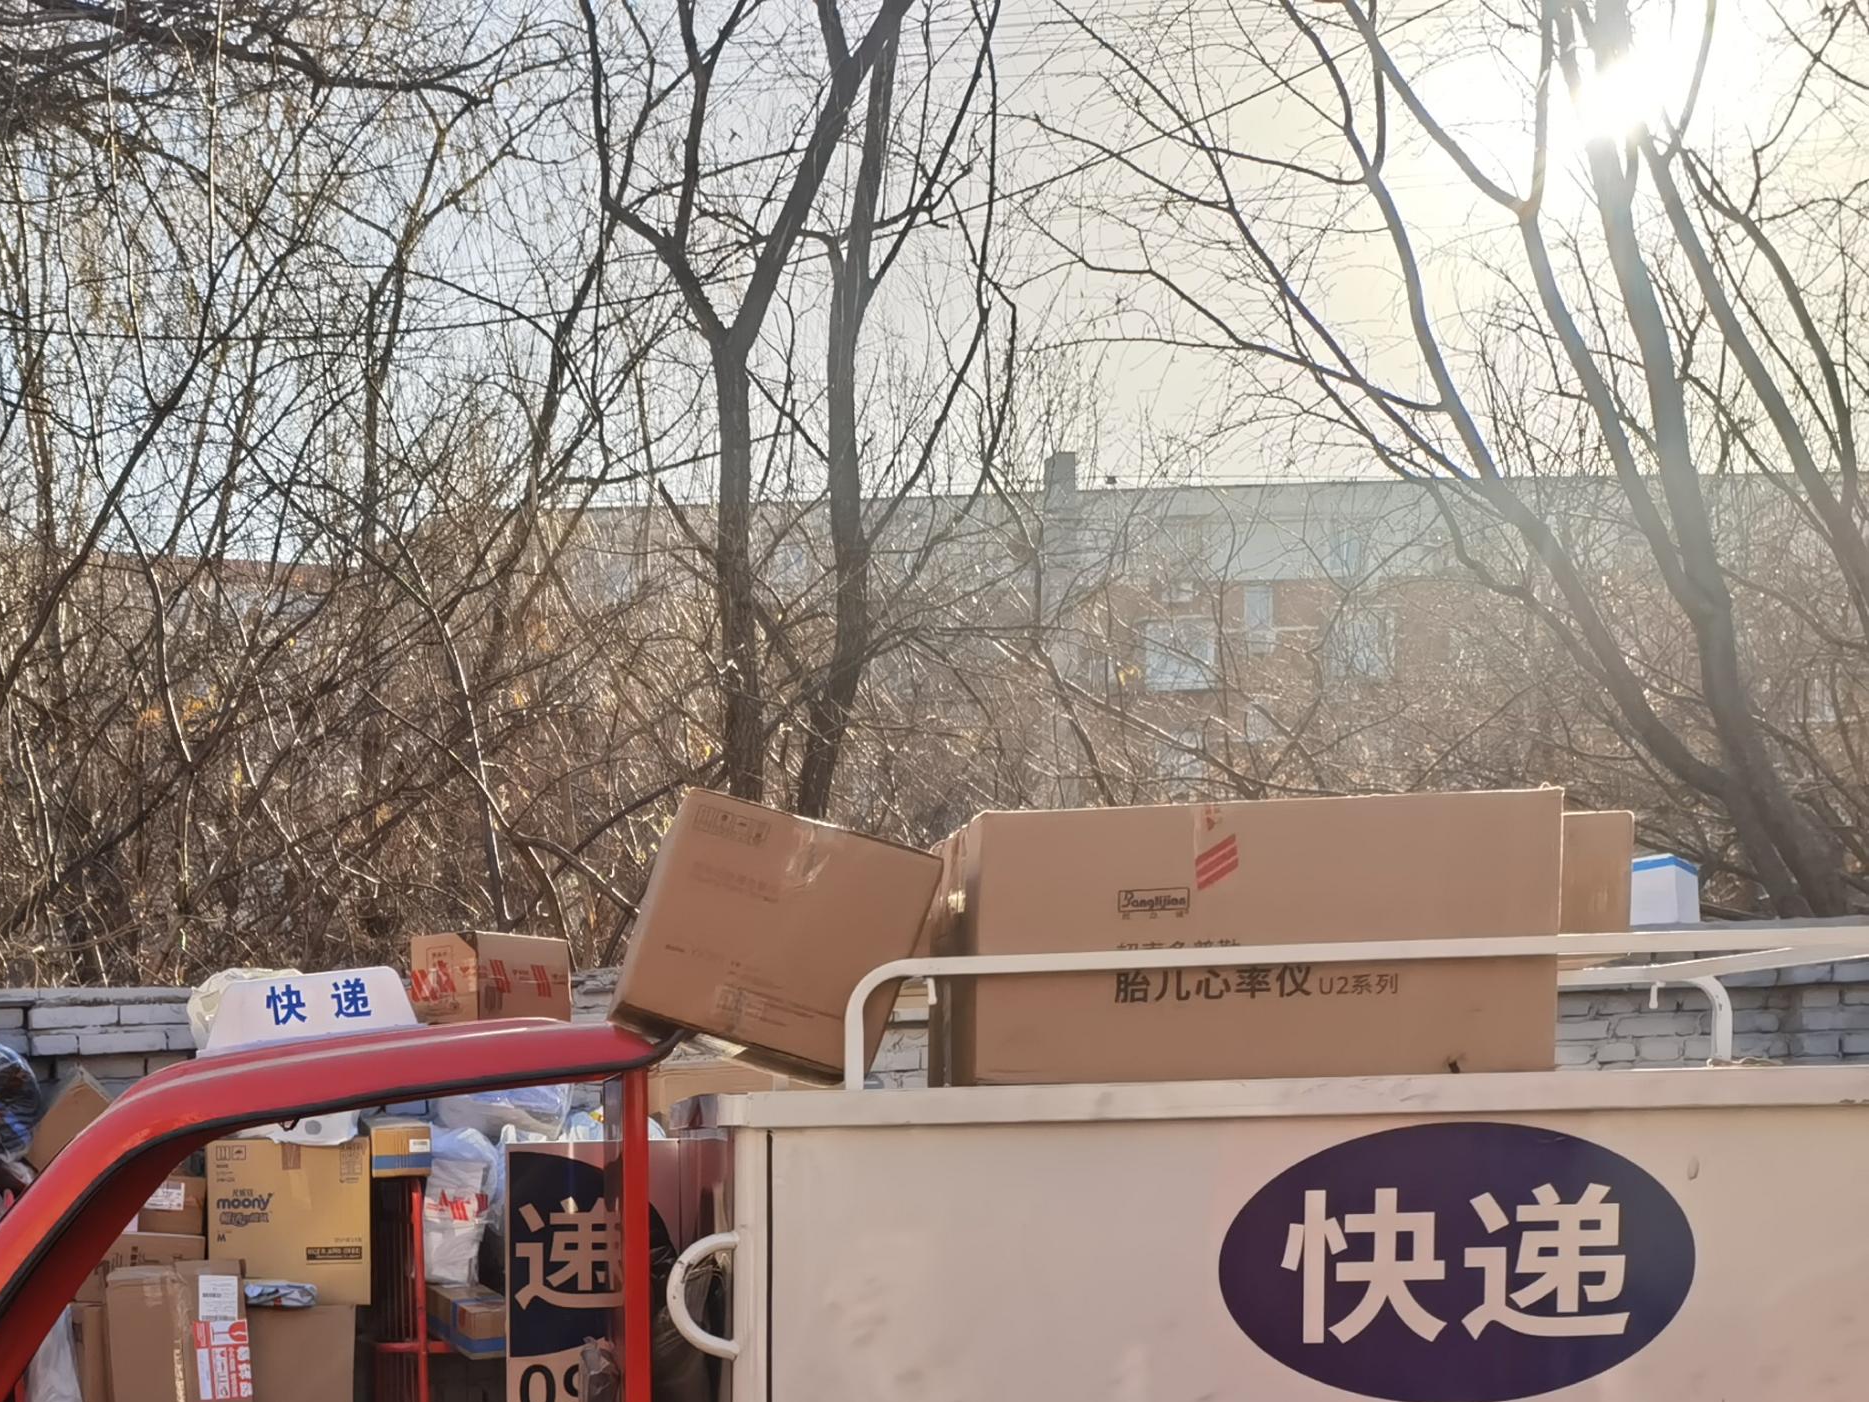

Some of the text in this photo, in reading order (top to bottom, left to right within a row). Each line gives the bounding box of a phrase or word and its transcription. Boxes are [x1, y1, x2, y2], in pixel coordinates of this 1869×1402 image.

[266, 977, 373, 1027] 快递
[1114, 963, 1399, 1005] 胎儿心率仪 U2系列
[216, 1192, 274, 1211] moony
[514, 1196, 624, 1310] 递
[1281, 1181, 1632, 1345] 快递
